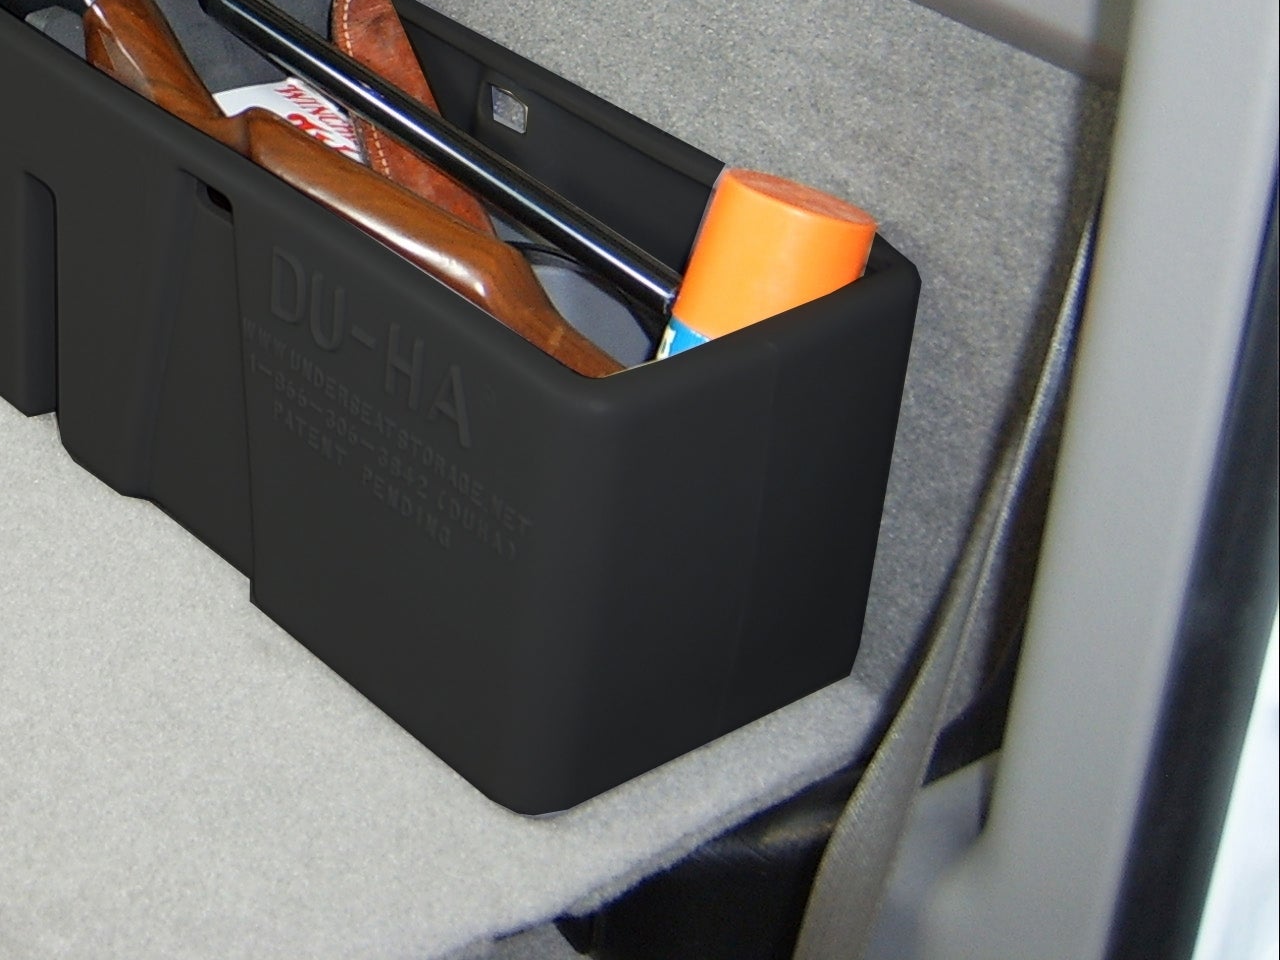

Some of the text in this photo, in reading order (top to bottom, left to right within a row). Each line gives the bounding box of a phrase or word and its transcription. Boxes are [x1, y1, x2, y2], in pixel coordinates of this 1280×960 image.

[270, 246, 473, 450] DU-HA
[272, 402, 453, 550] PATENT PENDING
